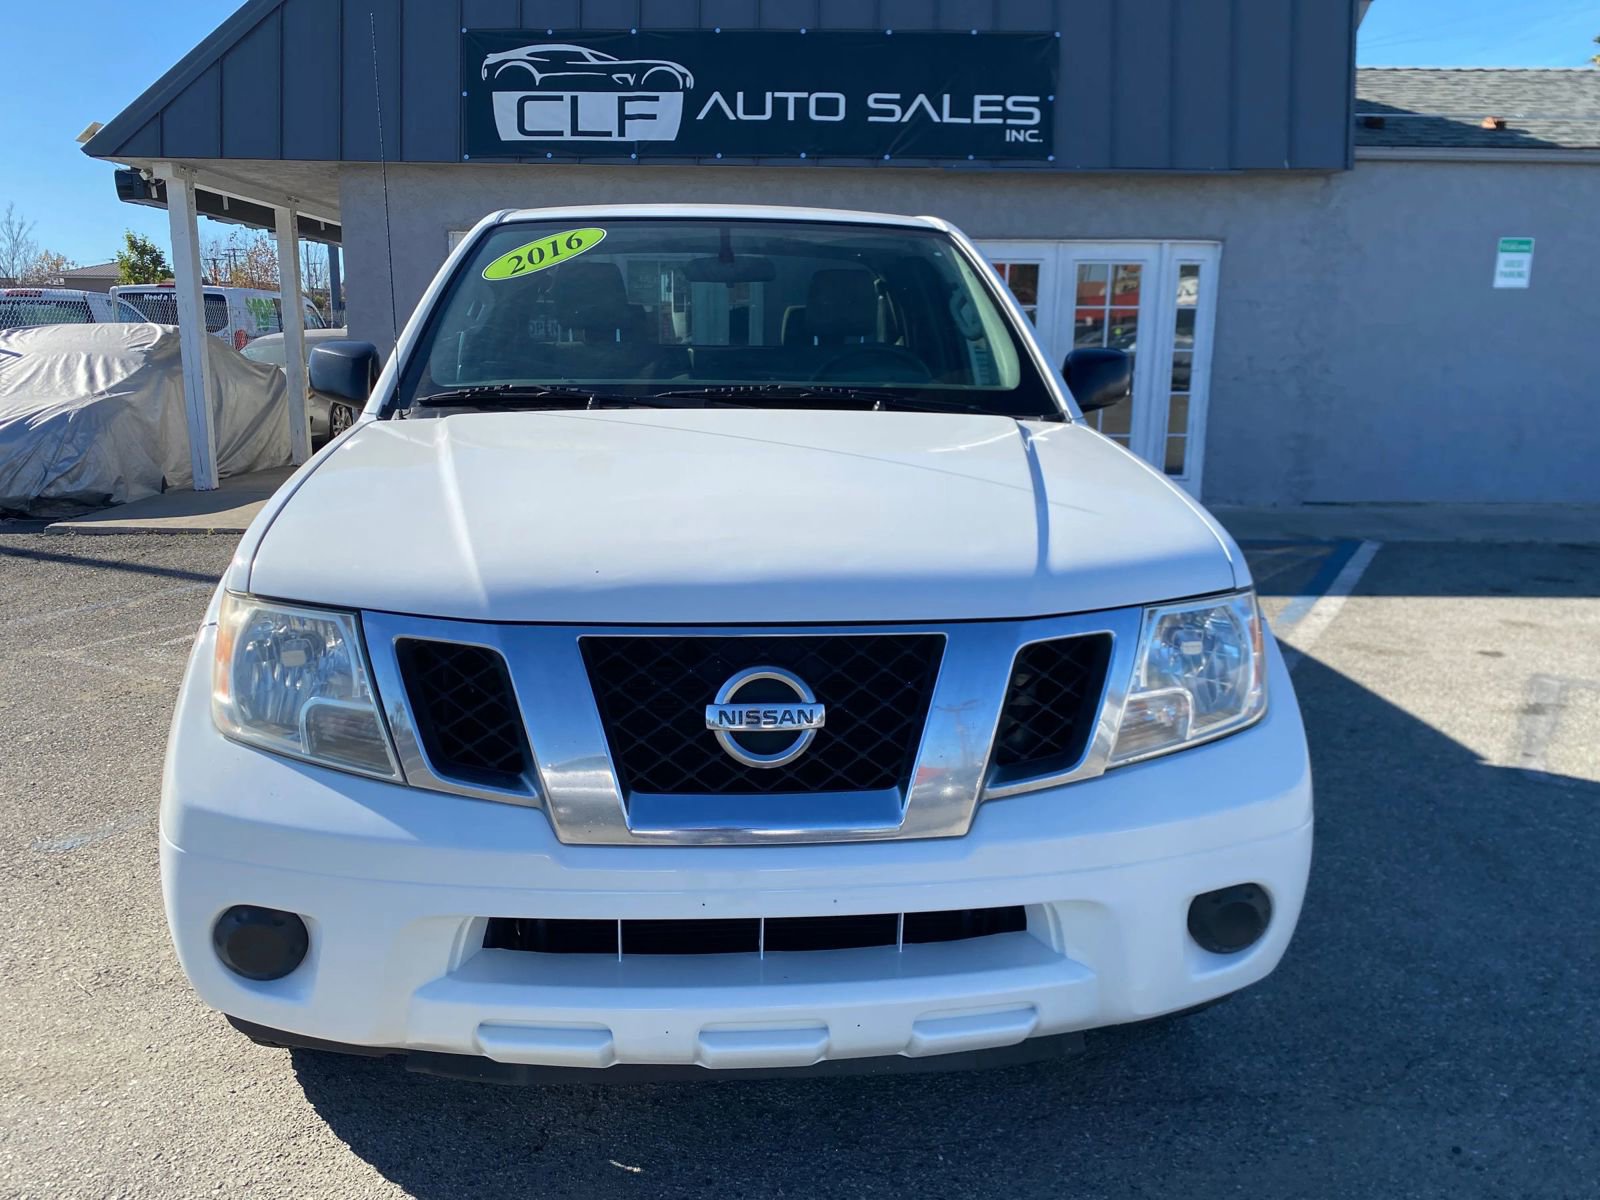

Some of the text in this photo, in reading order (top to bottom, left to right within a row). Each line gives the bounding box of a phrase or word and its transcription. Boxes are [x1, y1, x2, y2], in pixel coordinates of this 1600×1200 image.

[516, 91, 1041, 138] CLF AUTO SALES
[1005, 129, 1043, 143] INC.
[507, 231, 583, 275] 2016
[718, 709, 814, 725] NISSAN
